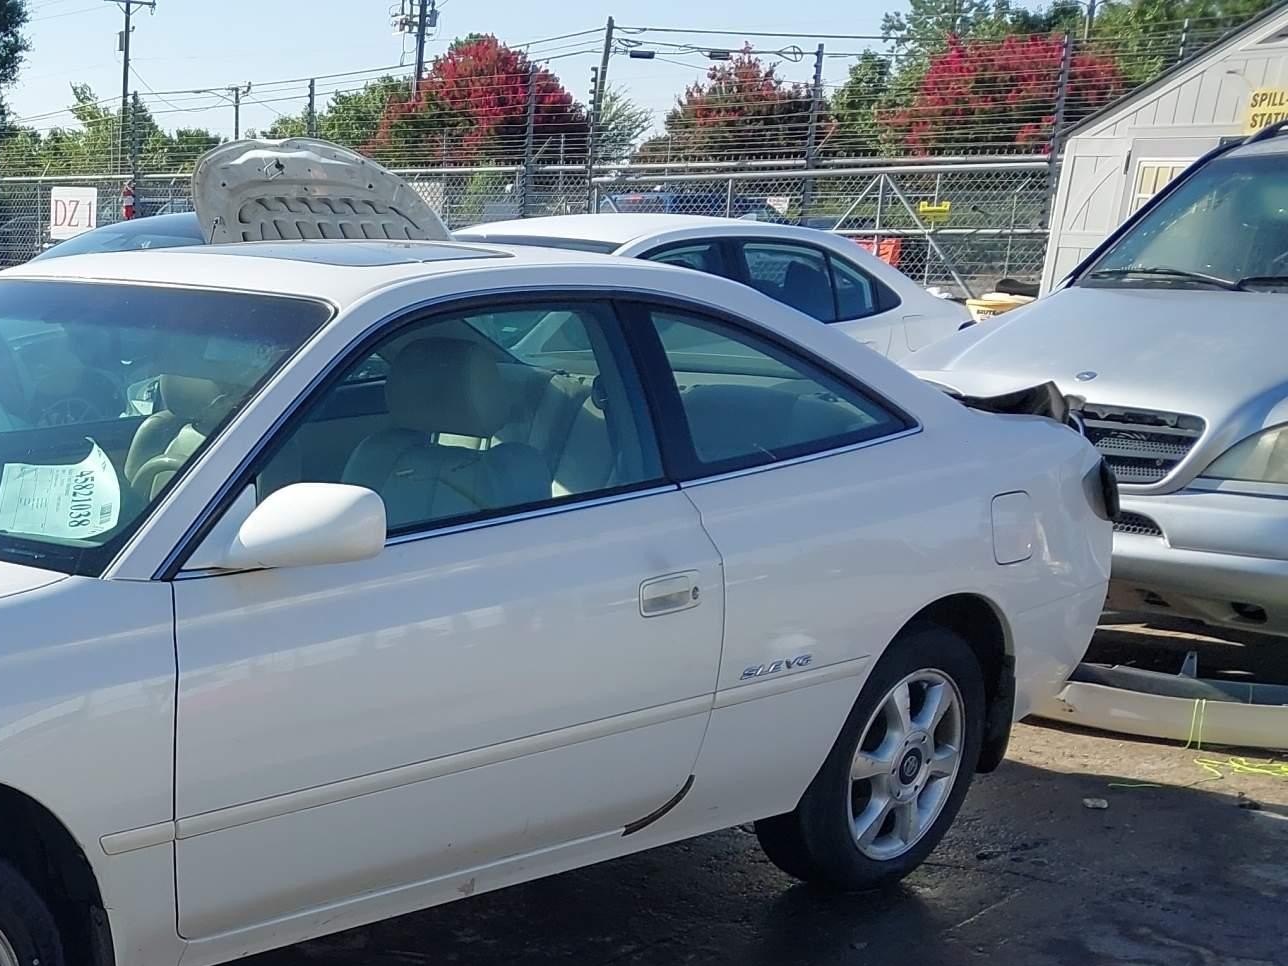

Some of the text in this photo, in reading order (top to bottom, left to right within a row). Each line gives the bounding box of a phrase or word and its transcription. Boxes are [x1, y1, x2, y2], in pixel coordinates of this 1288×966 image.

[54, 199, 93, 228] DZ 1
[68, 470, 95, 528] 45821038
